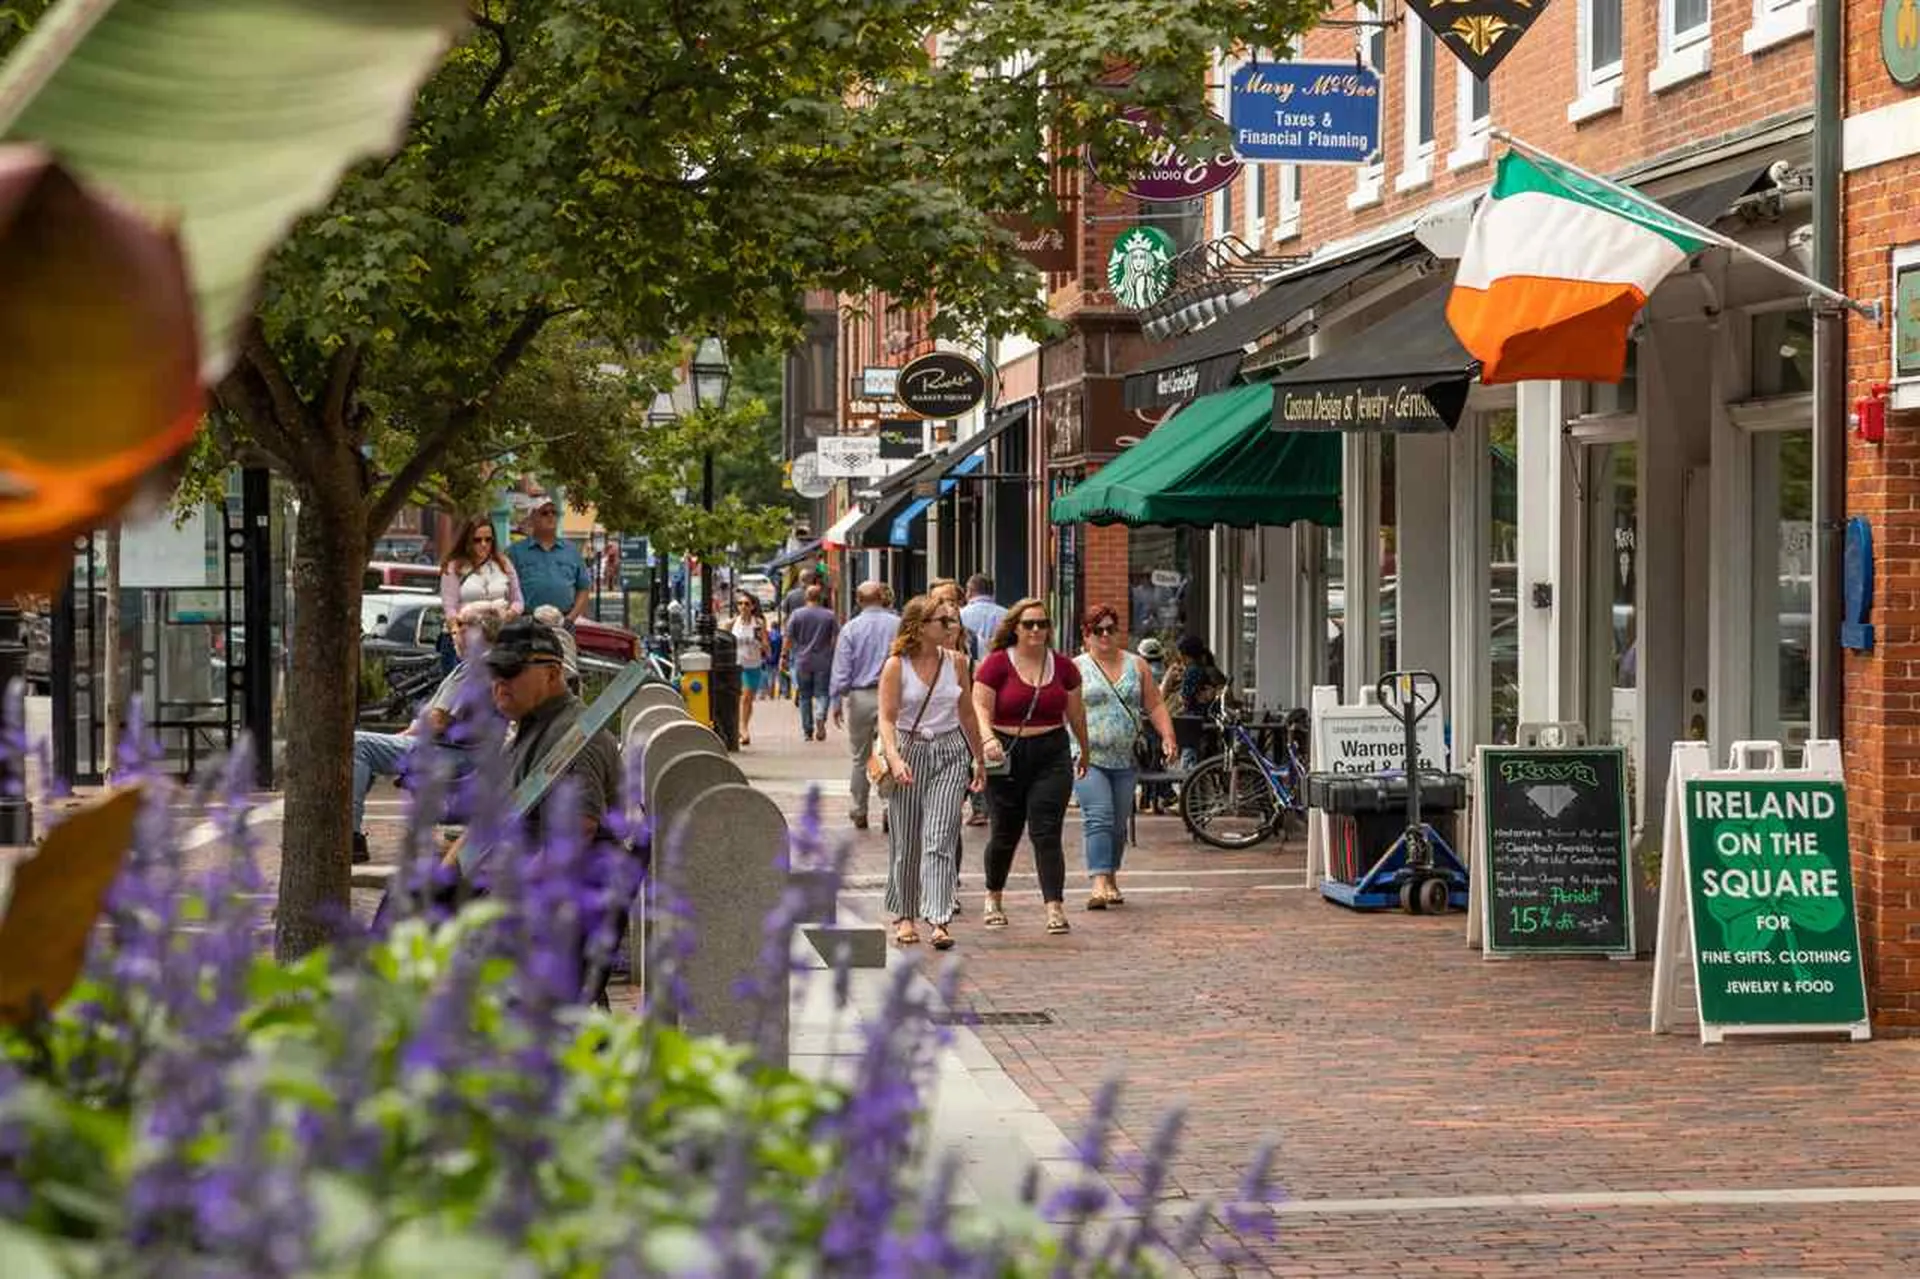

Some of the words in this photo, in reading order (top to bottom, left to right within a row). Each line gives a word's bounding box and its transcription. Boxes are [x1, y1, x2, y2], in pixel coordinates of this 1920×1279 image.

[1234, 72, 1295, 102] Mary
[1275, 110, 1316, 127] Taxes
[1321, 111, 1333, 128] &
[1239, 129, 1301, 145] Financial
[1308, 131, 1368, 150] Planning
[1343, 395, 1354, 420] &
[1696, 791, 1836, 819] IRELAND
[1717, 832, 1762, 856] ON
[1770, 832, 1818, 855] THE
[1702, 868, 1839, 898] SQUARE
[1510, 905, 1551, 933] 15%
[1757, 915, 1791, 931] FOR
[1702, 951, 1732, 964] FINE
[1734, 951, 1775, 967] GIFTS,
[1779, 950, 1852, 964] CLOTHING
[1724, 980, 1779, 994] JEWELRY
[1783, 980, 1792, 993] &
[1795, 980, 1834, 993] FOOD
